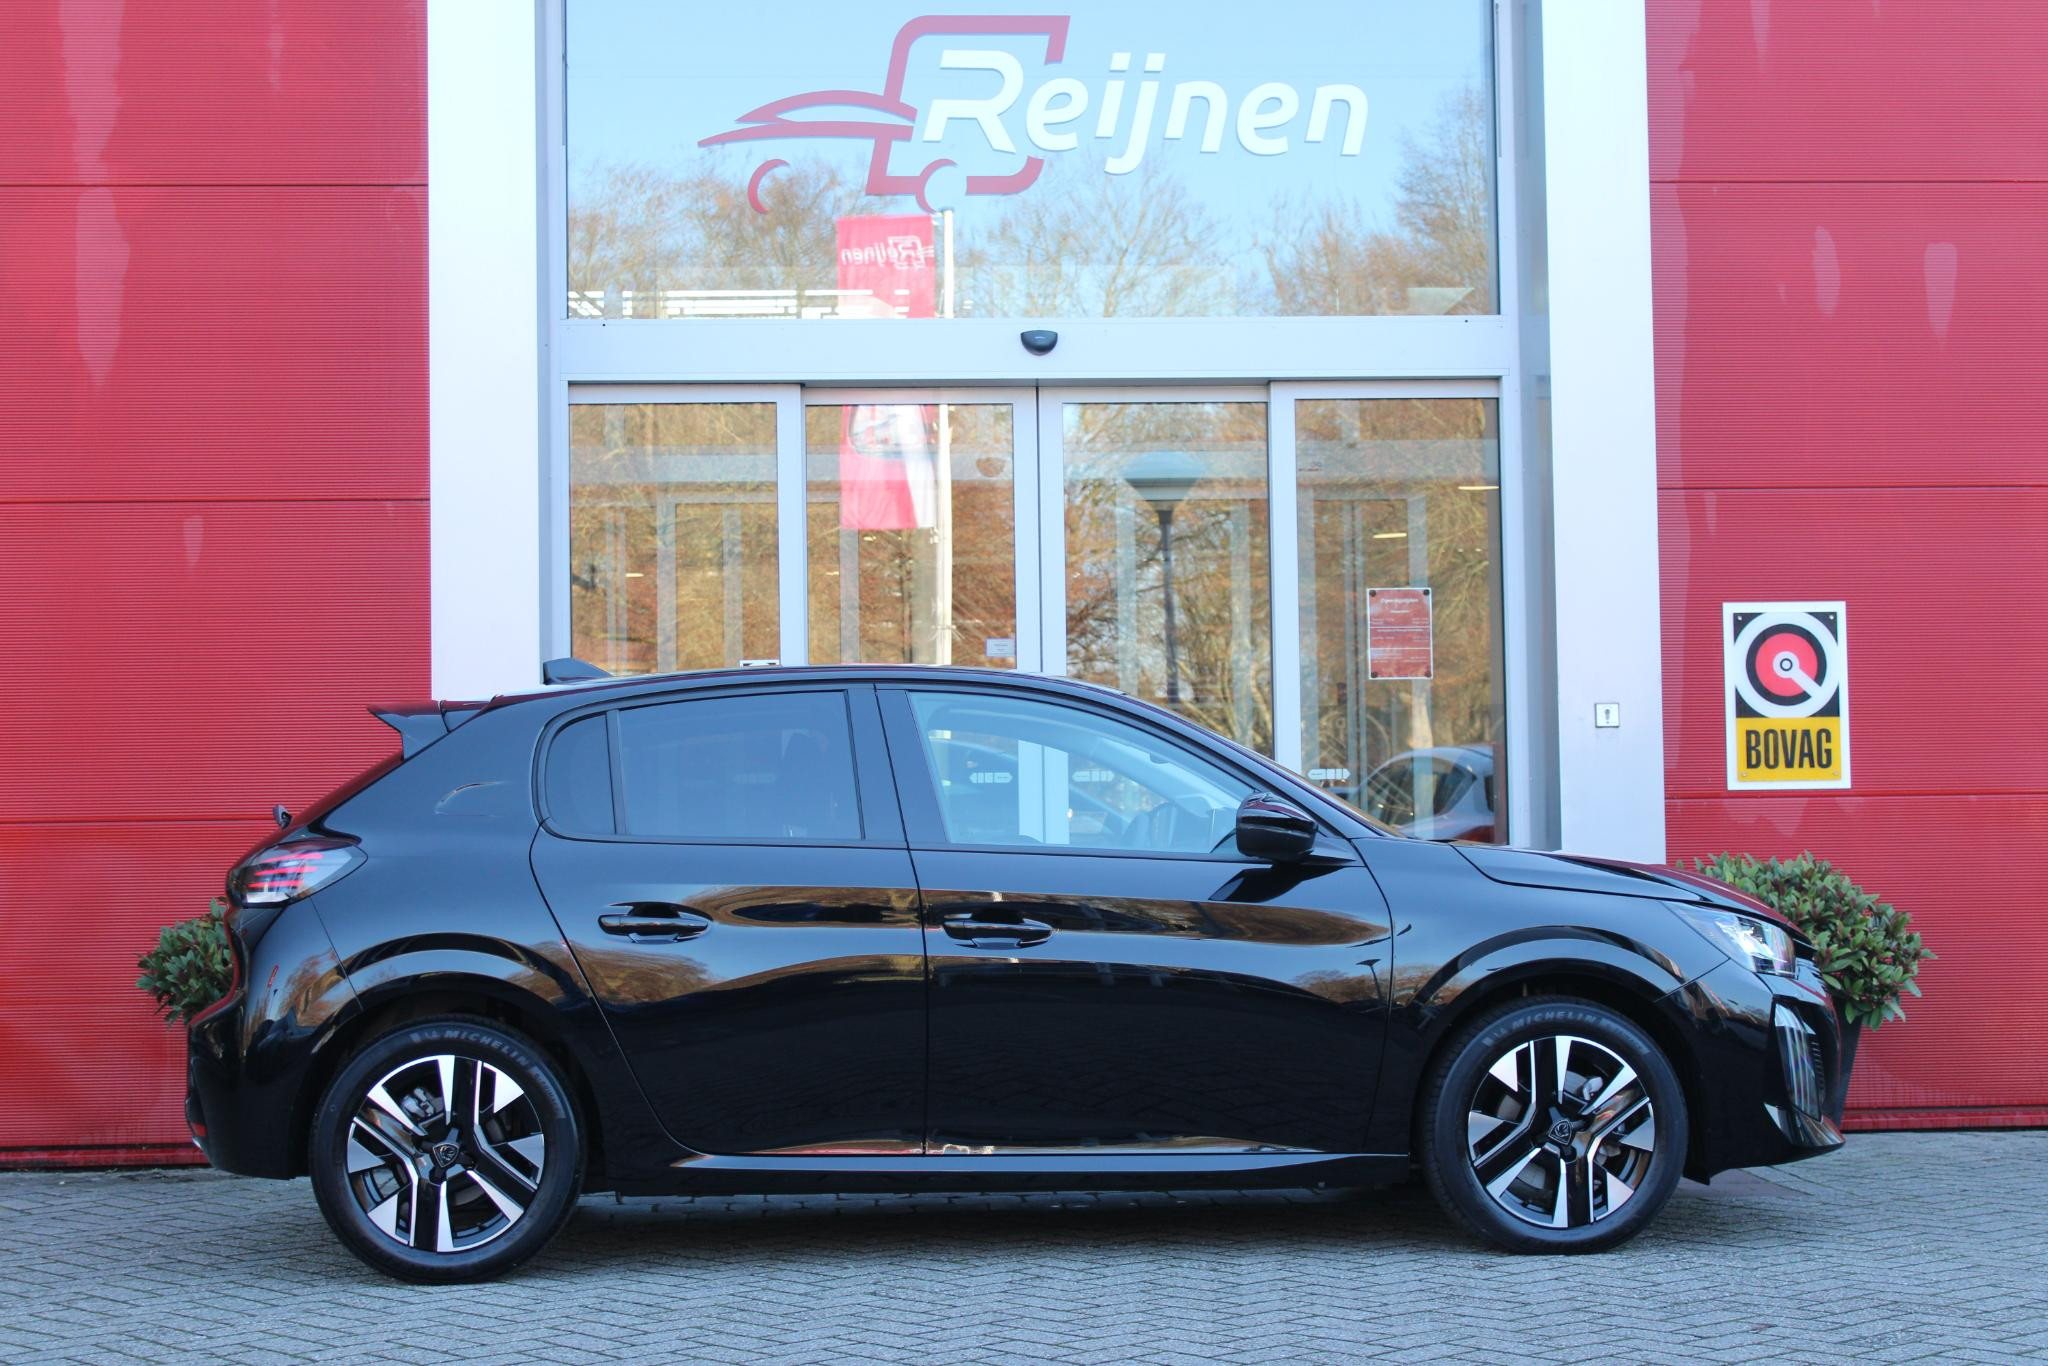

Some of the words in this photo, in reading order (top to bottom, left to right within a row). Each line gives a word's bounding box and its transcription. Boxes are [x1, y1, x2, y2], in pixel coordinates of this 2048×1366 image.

[922, 49, 1370, 176] Reijnen
[1745, 728, 1833, 769] BOVAG
[1511, 1010, 1598, 1031] MICHELIN
[443, 1029, 530, 1067] MICHELIN
